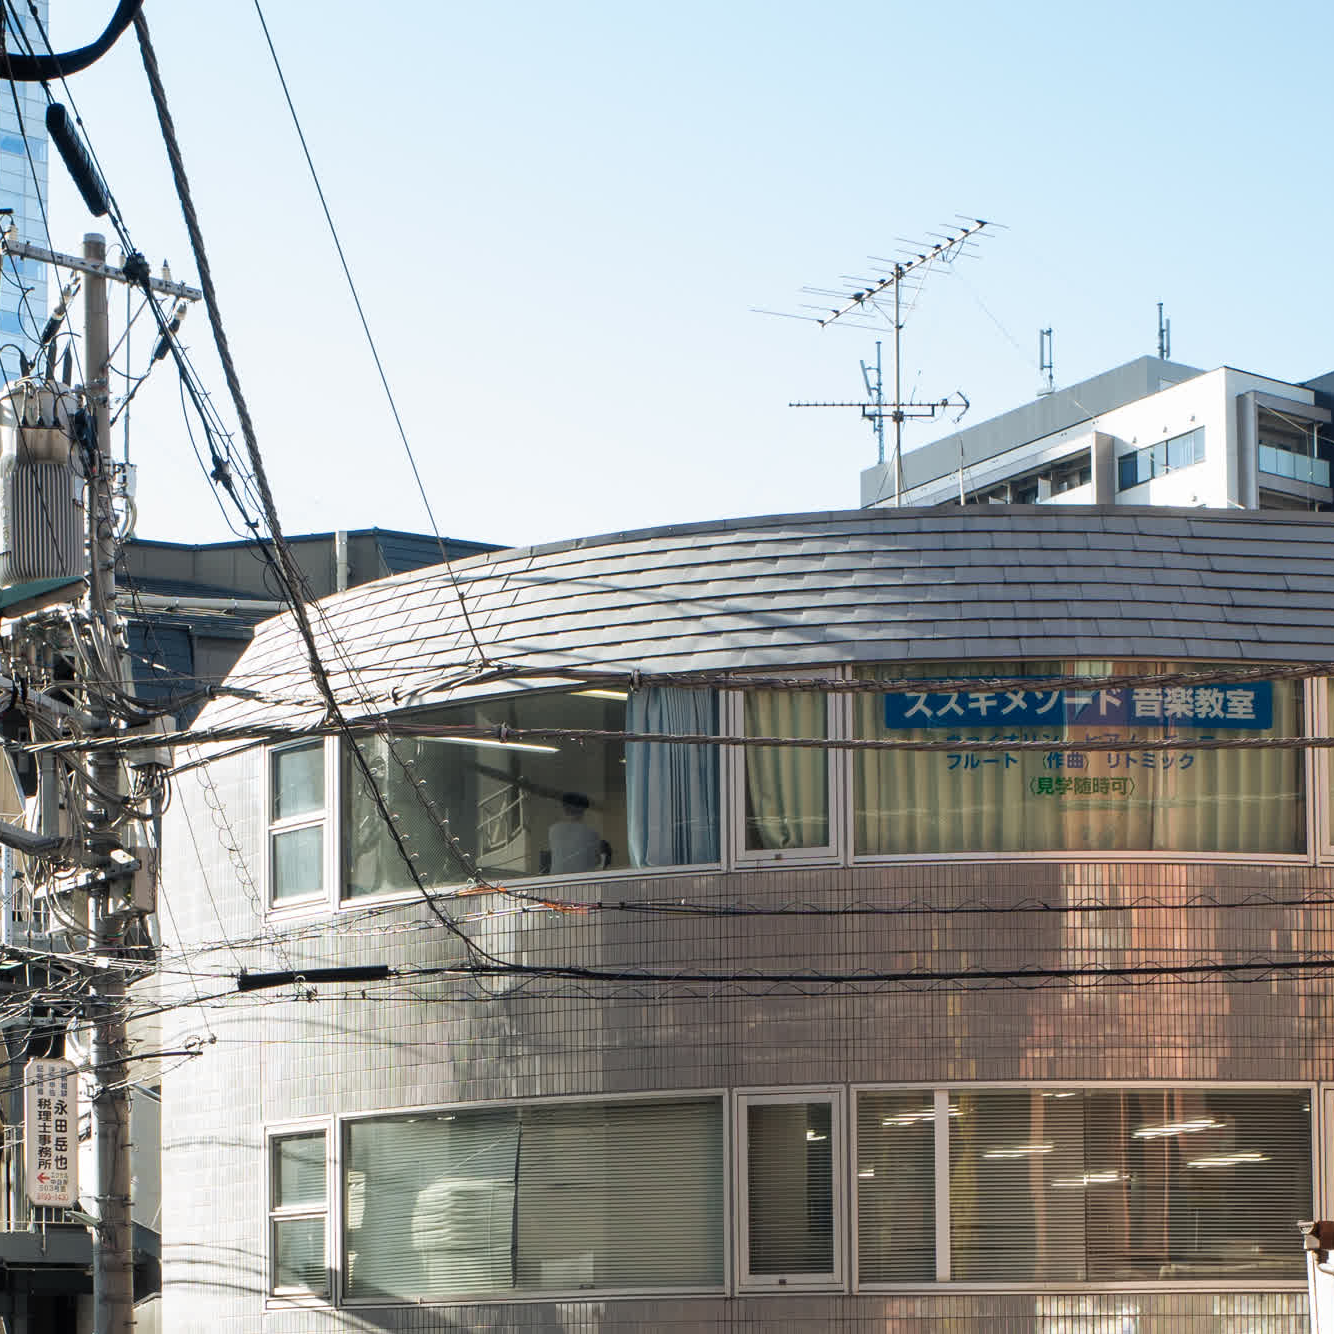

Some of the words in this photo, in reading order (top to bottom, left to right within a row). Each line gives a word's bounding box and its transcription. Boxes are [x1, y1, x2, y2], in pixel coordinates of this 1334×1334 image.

[1132, 687, 1257, 719] 音楽教室
[947, 752, 1018, 770] フルート
[1106, 752, 1195, 770] リトミック
[37, 1098, 52, 1170] 税理士事務所
[54, 1100, 68, 1171] 永田岳也
